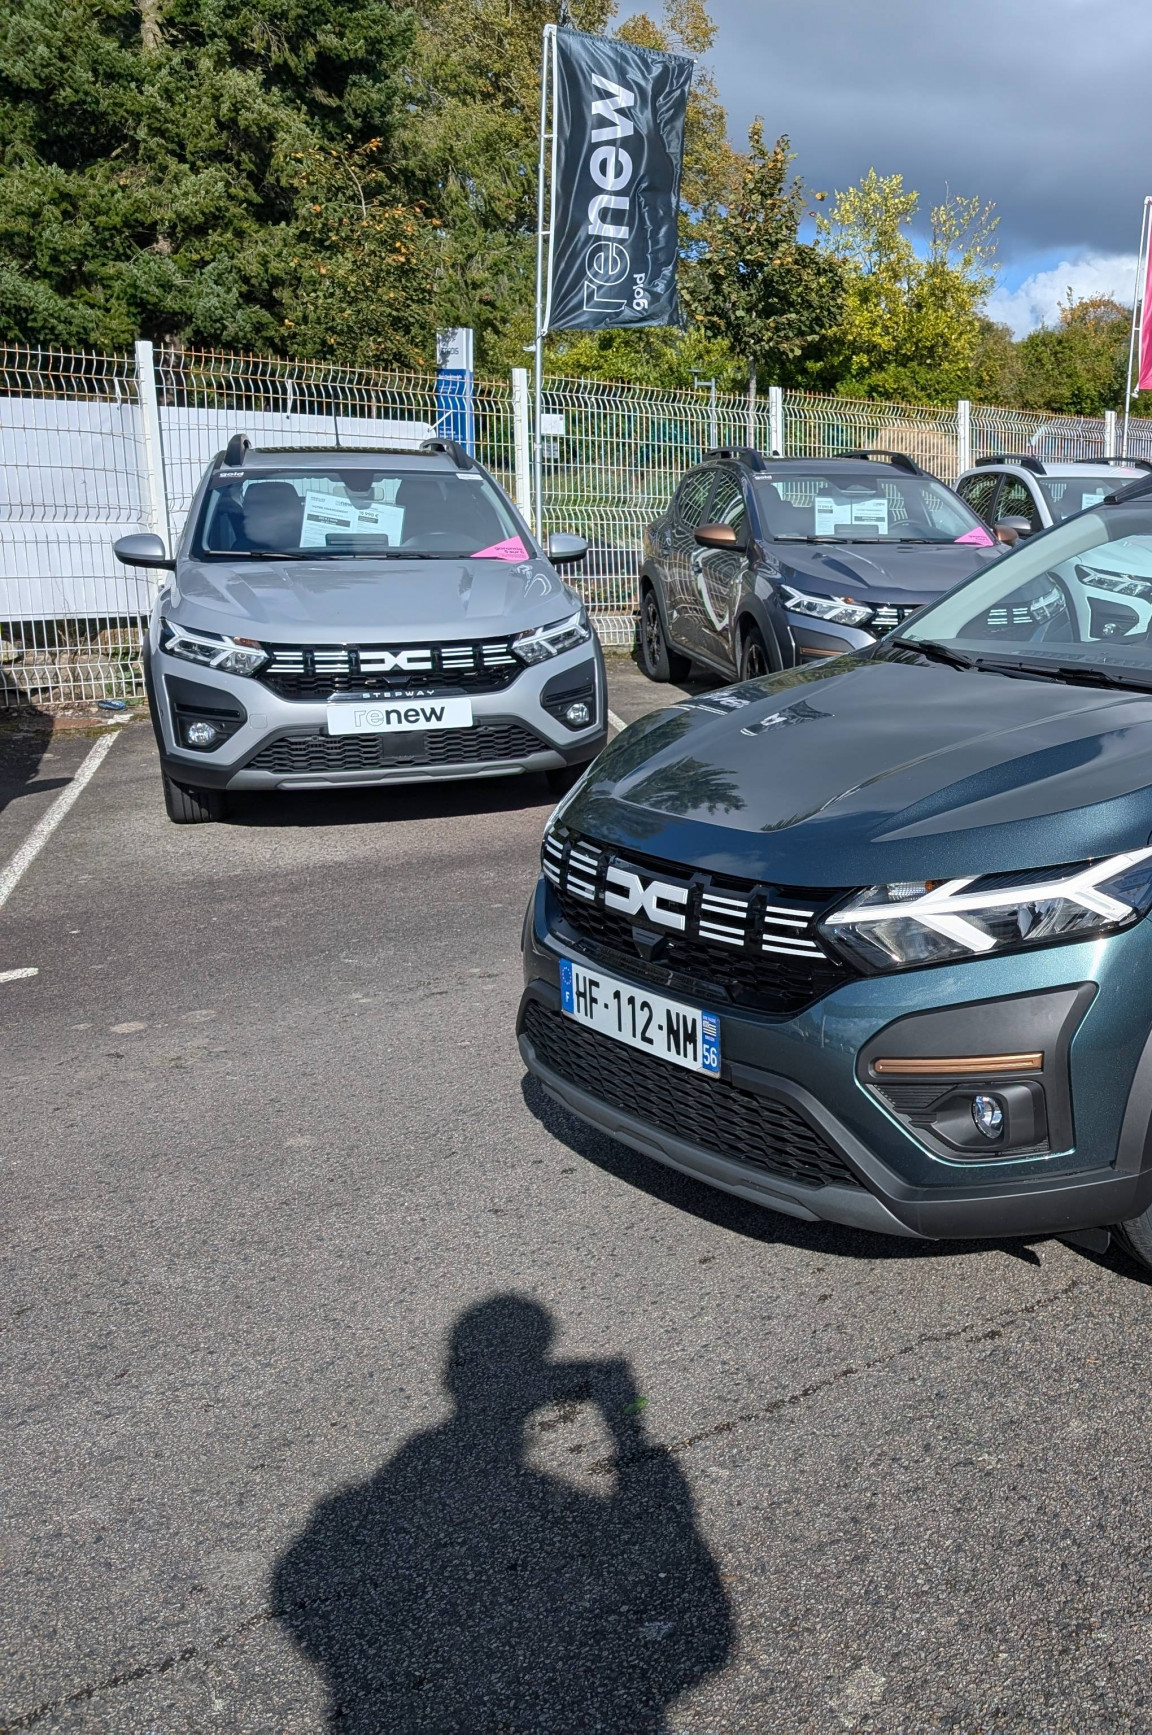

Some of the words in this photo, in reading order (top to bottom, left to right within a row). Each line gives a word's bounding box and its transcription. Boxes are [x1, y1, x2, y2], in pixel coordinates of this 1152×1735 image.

[583, 72, 635, 313] renew
[633, 273, 648, 310] gold
[362, 689, 435, 699] STEPWAY
[353, 706, 446, 728] renew
[565, 991, 570, 1003] F
[575, 972, 698, 1062] HF-112-NM
[703, 1044, 718, 1068] 56
